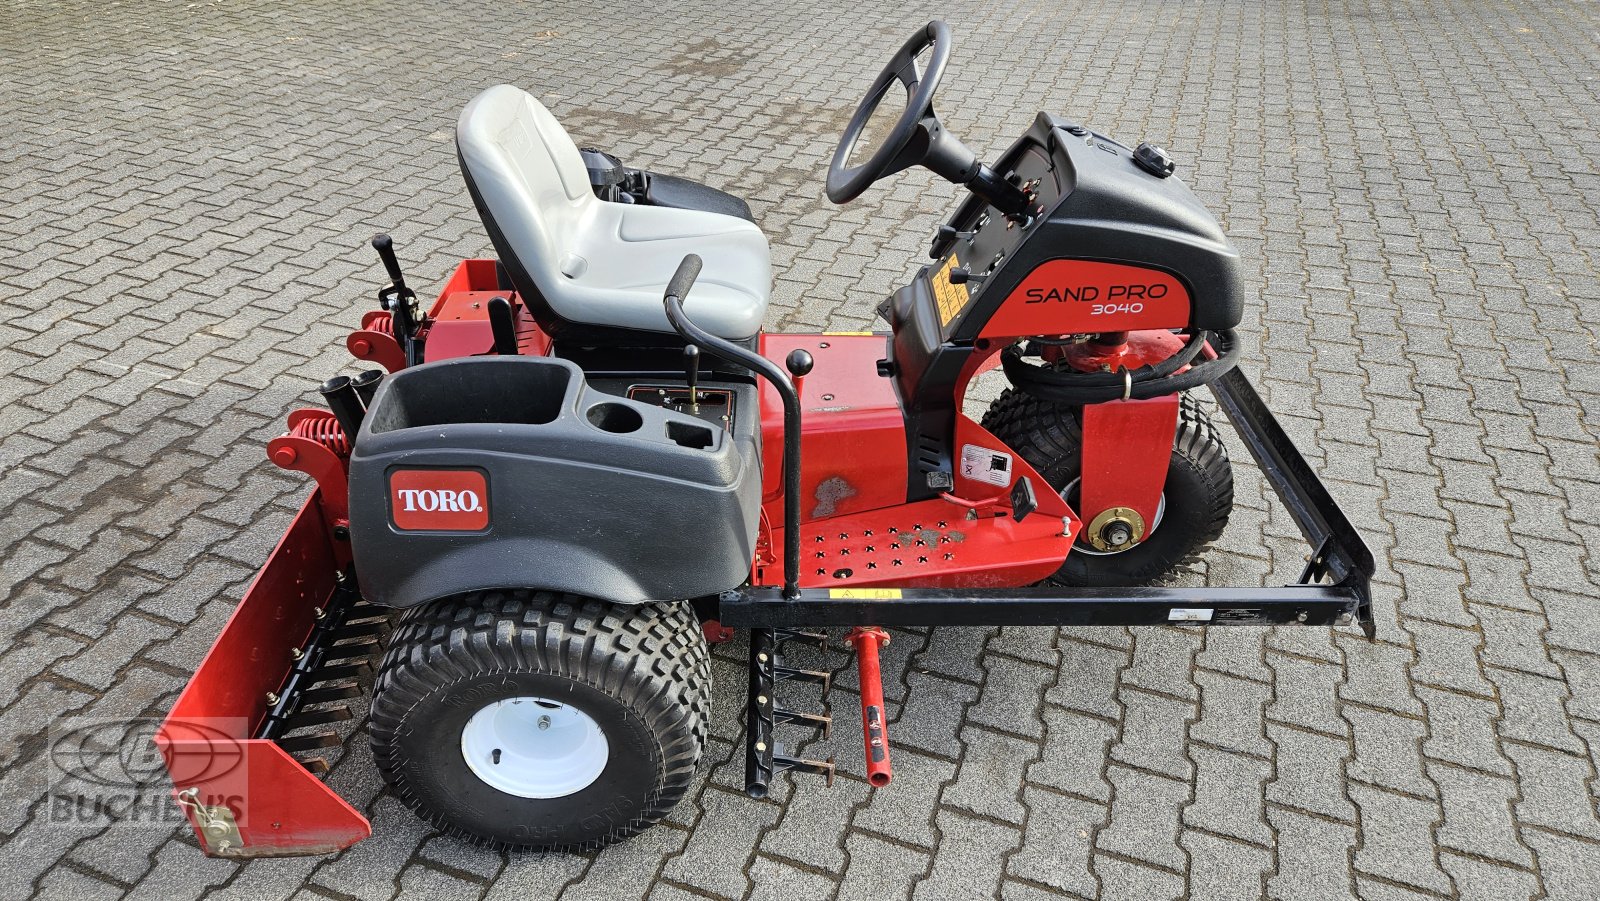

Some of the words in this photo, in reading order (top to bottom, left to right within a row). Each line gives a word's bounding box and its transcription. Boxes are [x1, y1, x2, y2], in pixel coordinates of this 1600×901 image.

[1025, 286, 1099, 304] SAND
[1107, 283, 1168, 301] PRO
[1090, 302, 1143, 315] 3040
[397, 489, 482, 512] TORO
